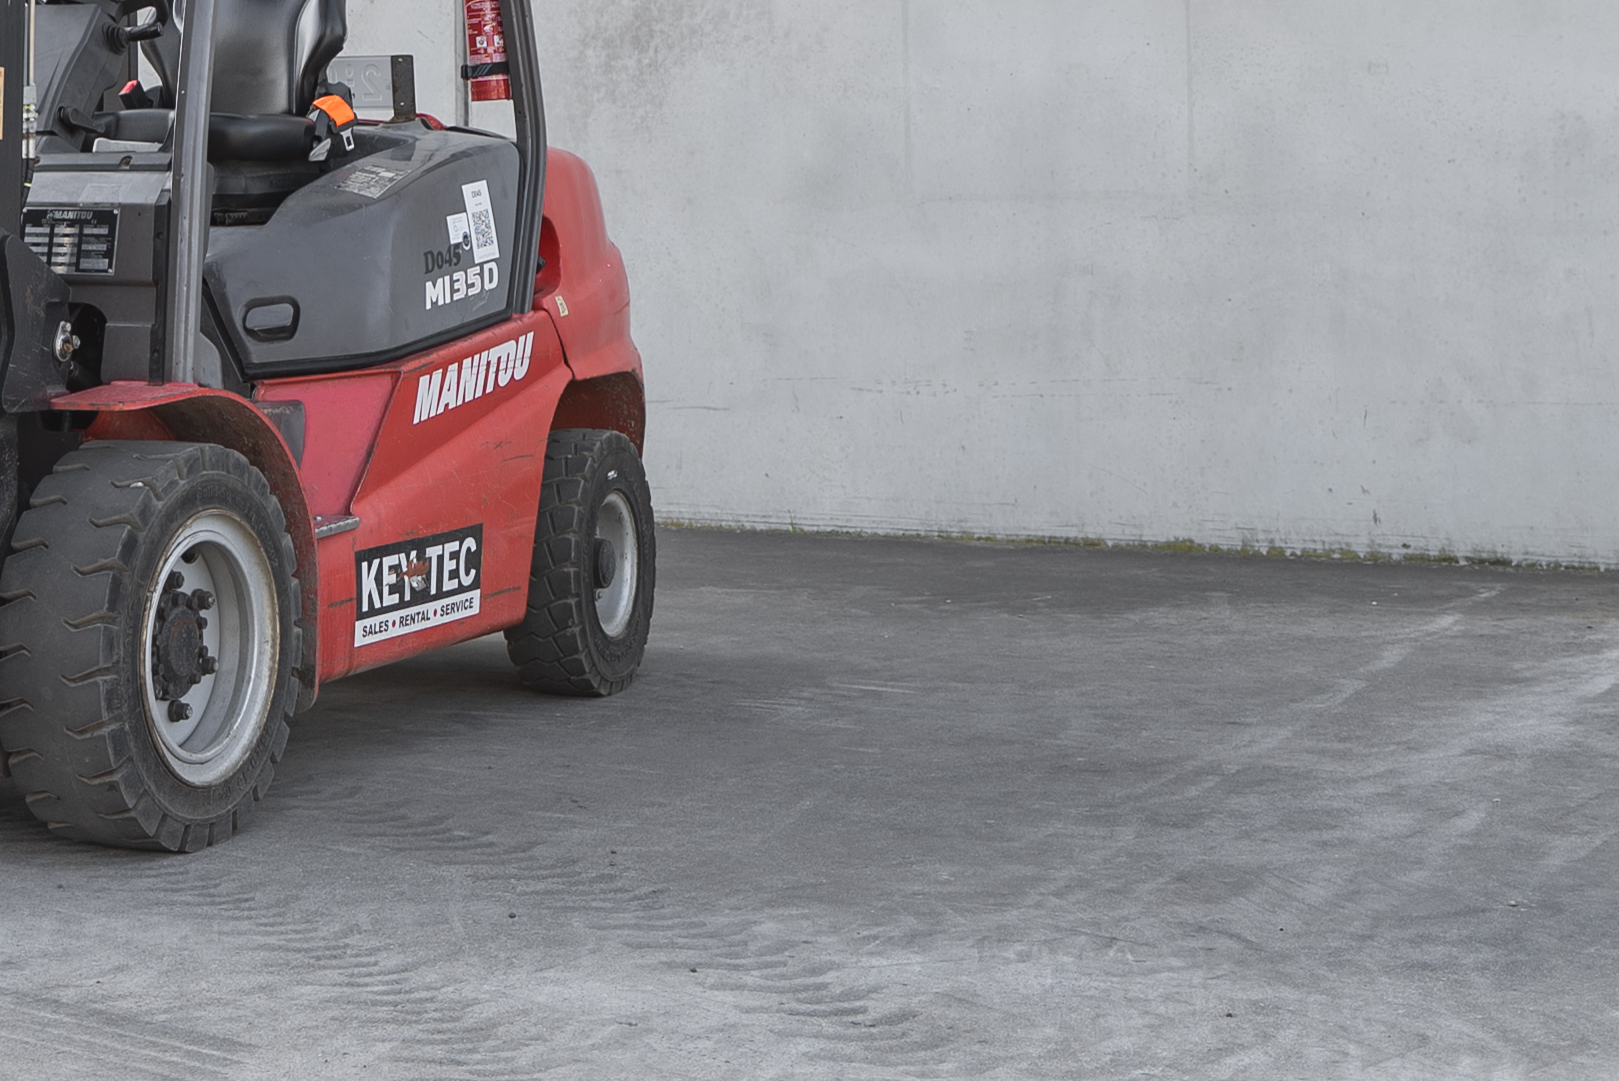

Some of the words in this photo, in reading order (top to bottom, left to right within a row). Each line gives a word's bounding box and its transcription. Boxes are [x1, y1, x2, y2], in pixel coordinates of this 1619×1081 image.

[412, 331, 534, 425] MANITOU
[362, 619, 390, 638] SALES
[398, 609, 431, 629] RENTAL
[439, 597, 475, 618] SERVICE
